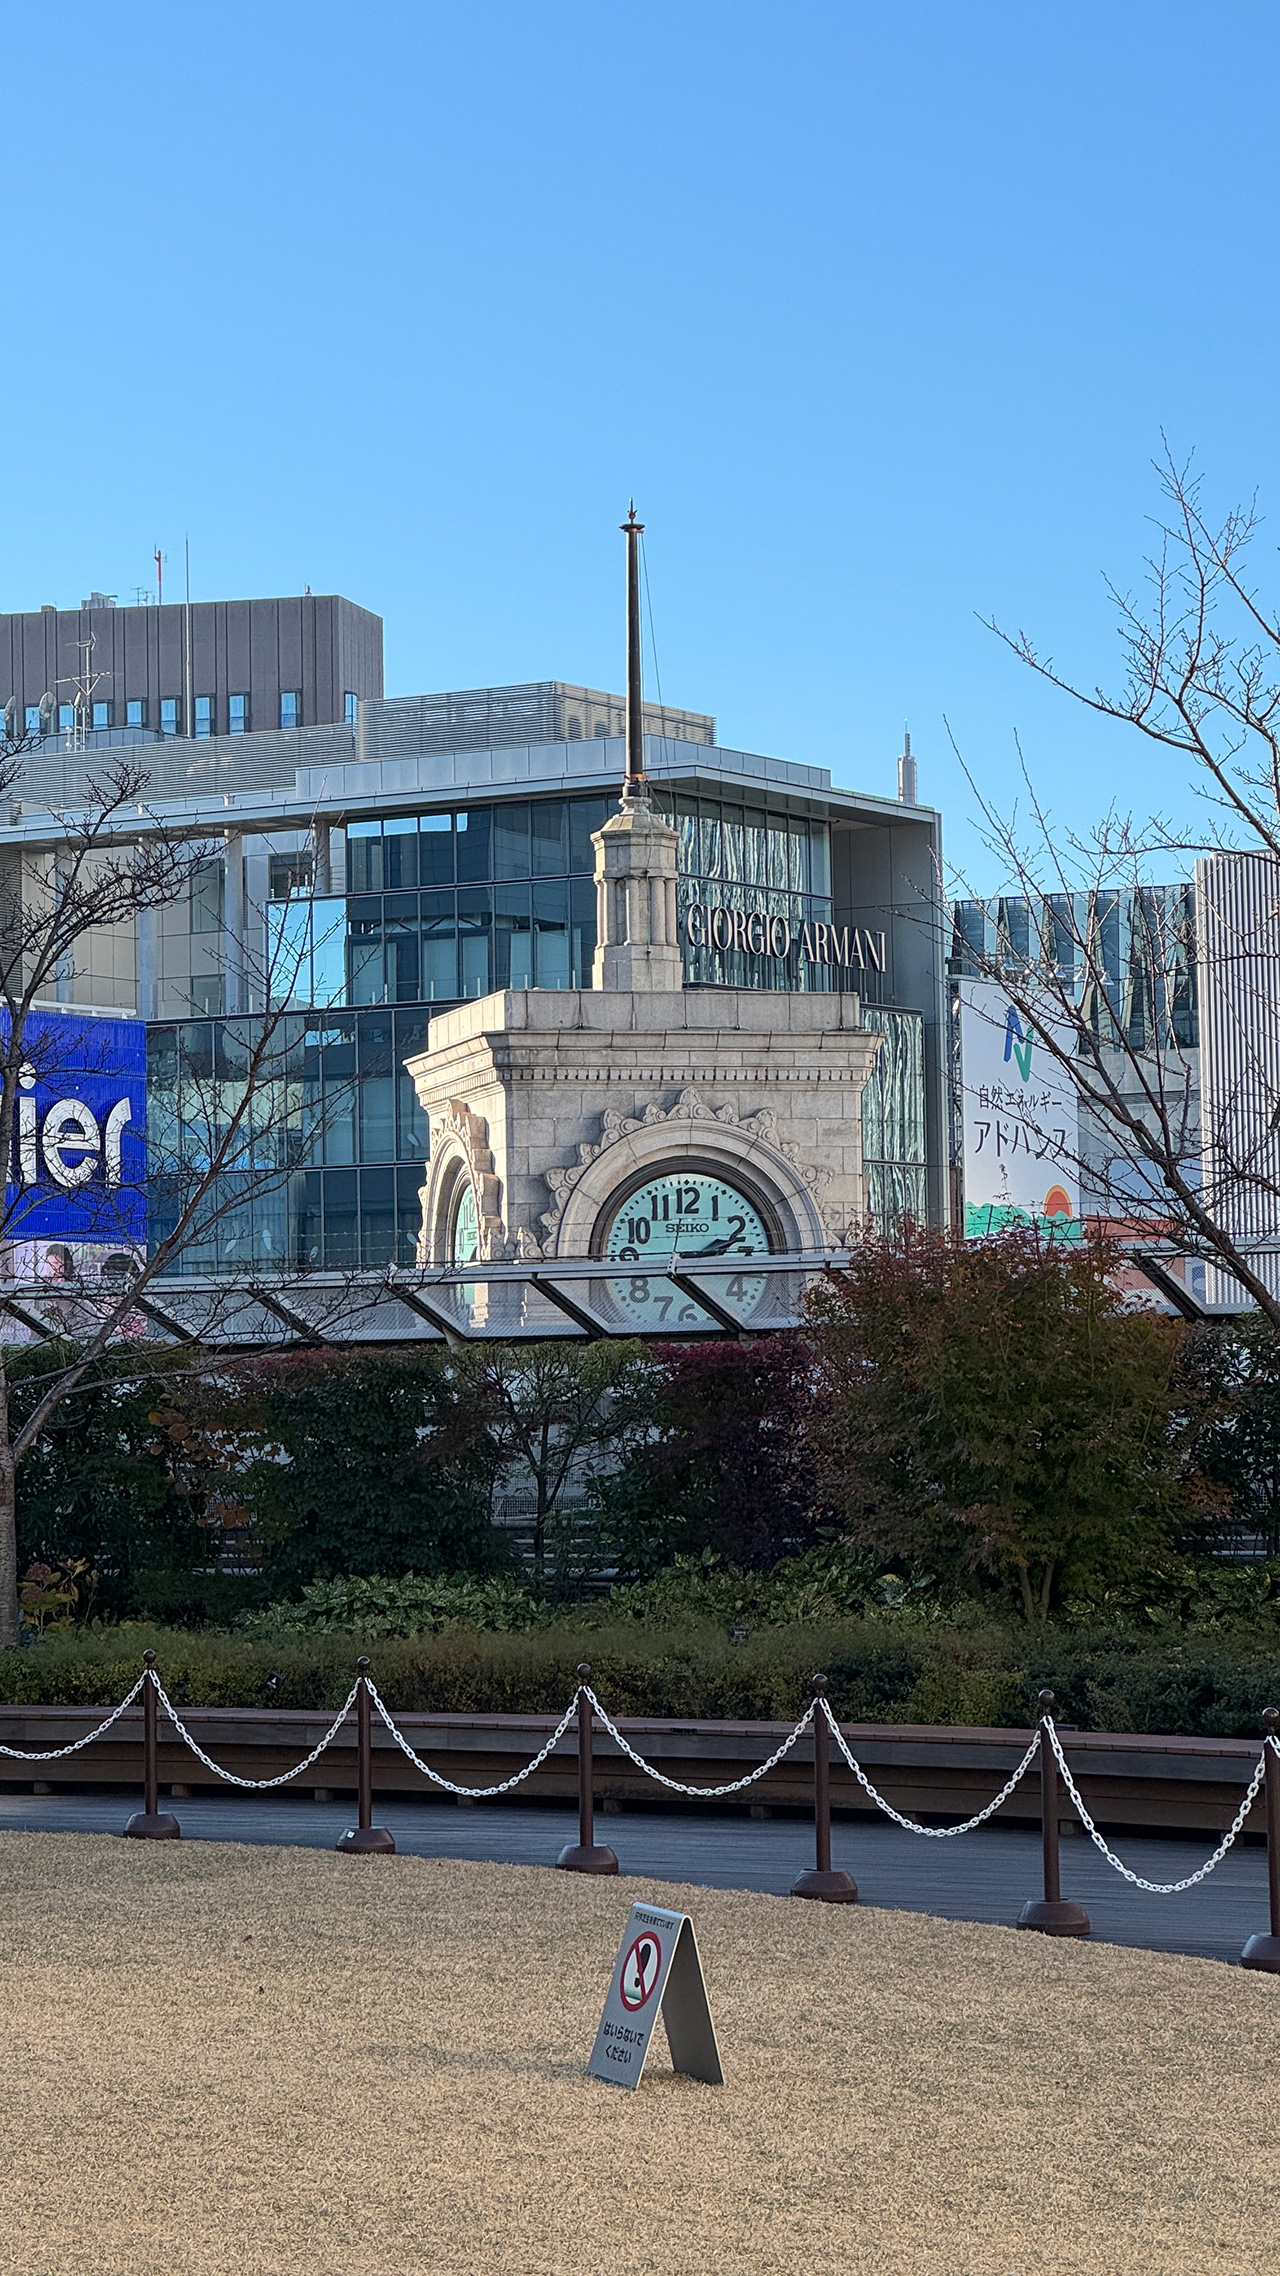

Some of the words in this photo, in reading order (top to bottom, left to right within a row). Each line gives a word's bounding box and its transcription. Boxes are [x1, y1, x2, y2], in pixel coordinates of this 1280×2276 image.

[685, 903, 791, 959] GIORGIO
[799, 920, 887, 972] ARMANI
[979, 1083, 1063, 1114] 自然エネルギー
[5, 1061, 132, 1189] ier
[651, 1194, 669, 1222] 11
[676, 1186, 700, 1214] 12
[711, 1194, 719, 1222] 1
[628, 1216, 651, 1245] 10
[666, 1223, 710, 1233] SEIKO
[727, 1215, 746, 1243] 2
[629, 1277, 650, 1304] 8
[725, 1274, 748, 1303] 4
[653, 1295, 674, 1322] 7
[603, 2020, 645, 2047] はいらないで
[605, 2044, 632, 2064] ください
